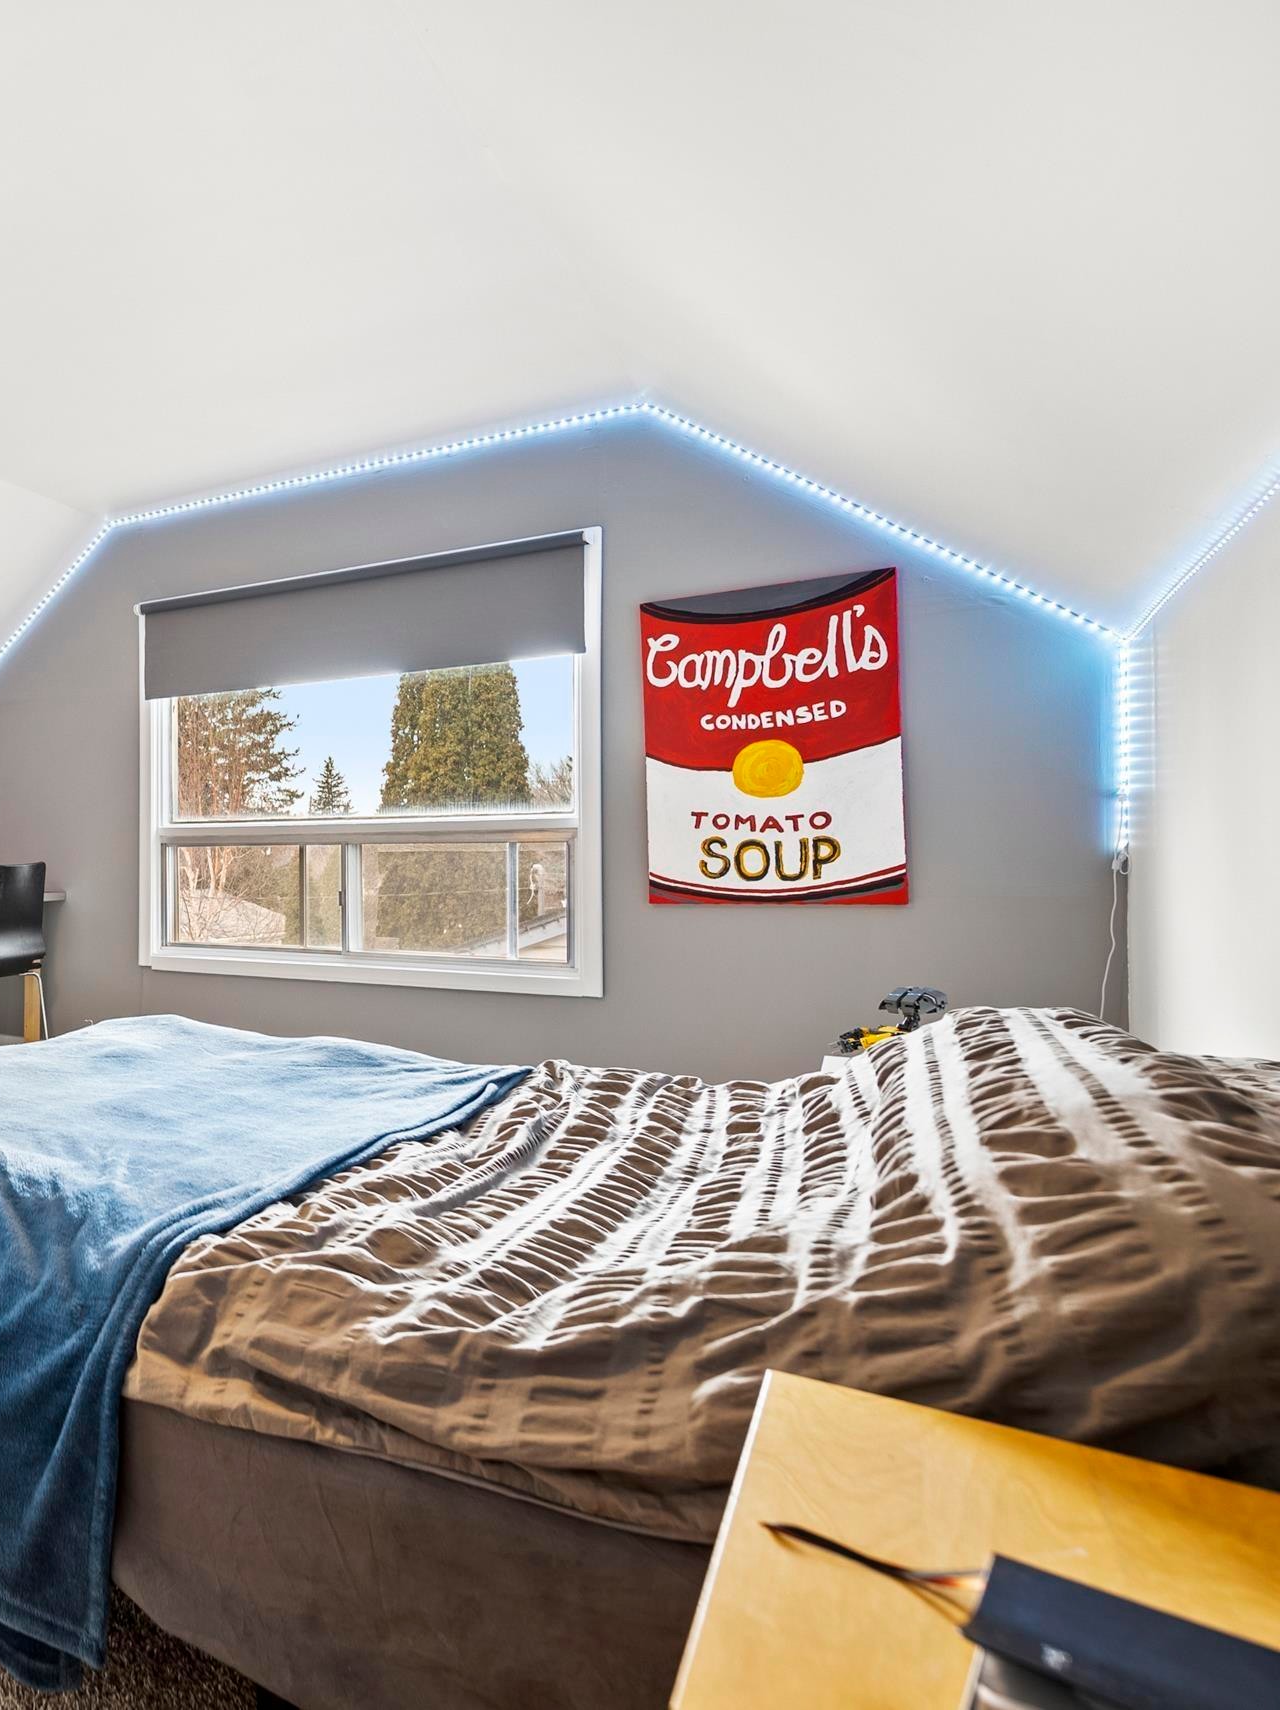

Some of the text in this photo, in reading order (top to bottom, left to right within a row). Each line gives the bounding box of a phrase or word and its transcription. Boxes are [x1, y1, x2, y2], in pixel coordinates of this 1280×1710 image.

[646, 604, 889, 708] Campbell's
[700, 700, 847, 731] CONDENSED
[690, 811, 832, 834] TOMATO
[698, 835, 842, 882] SOUP
